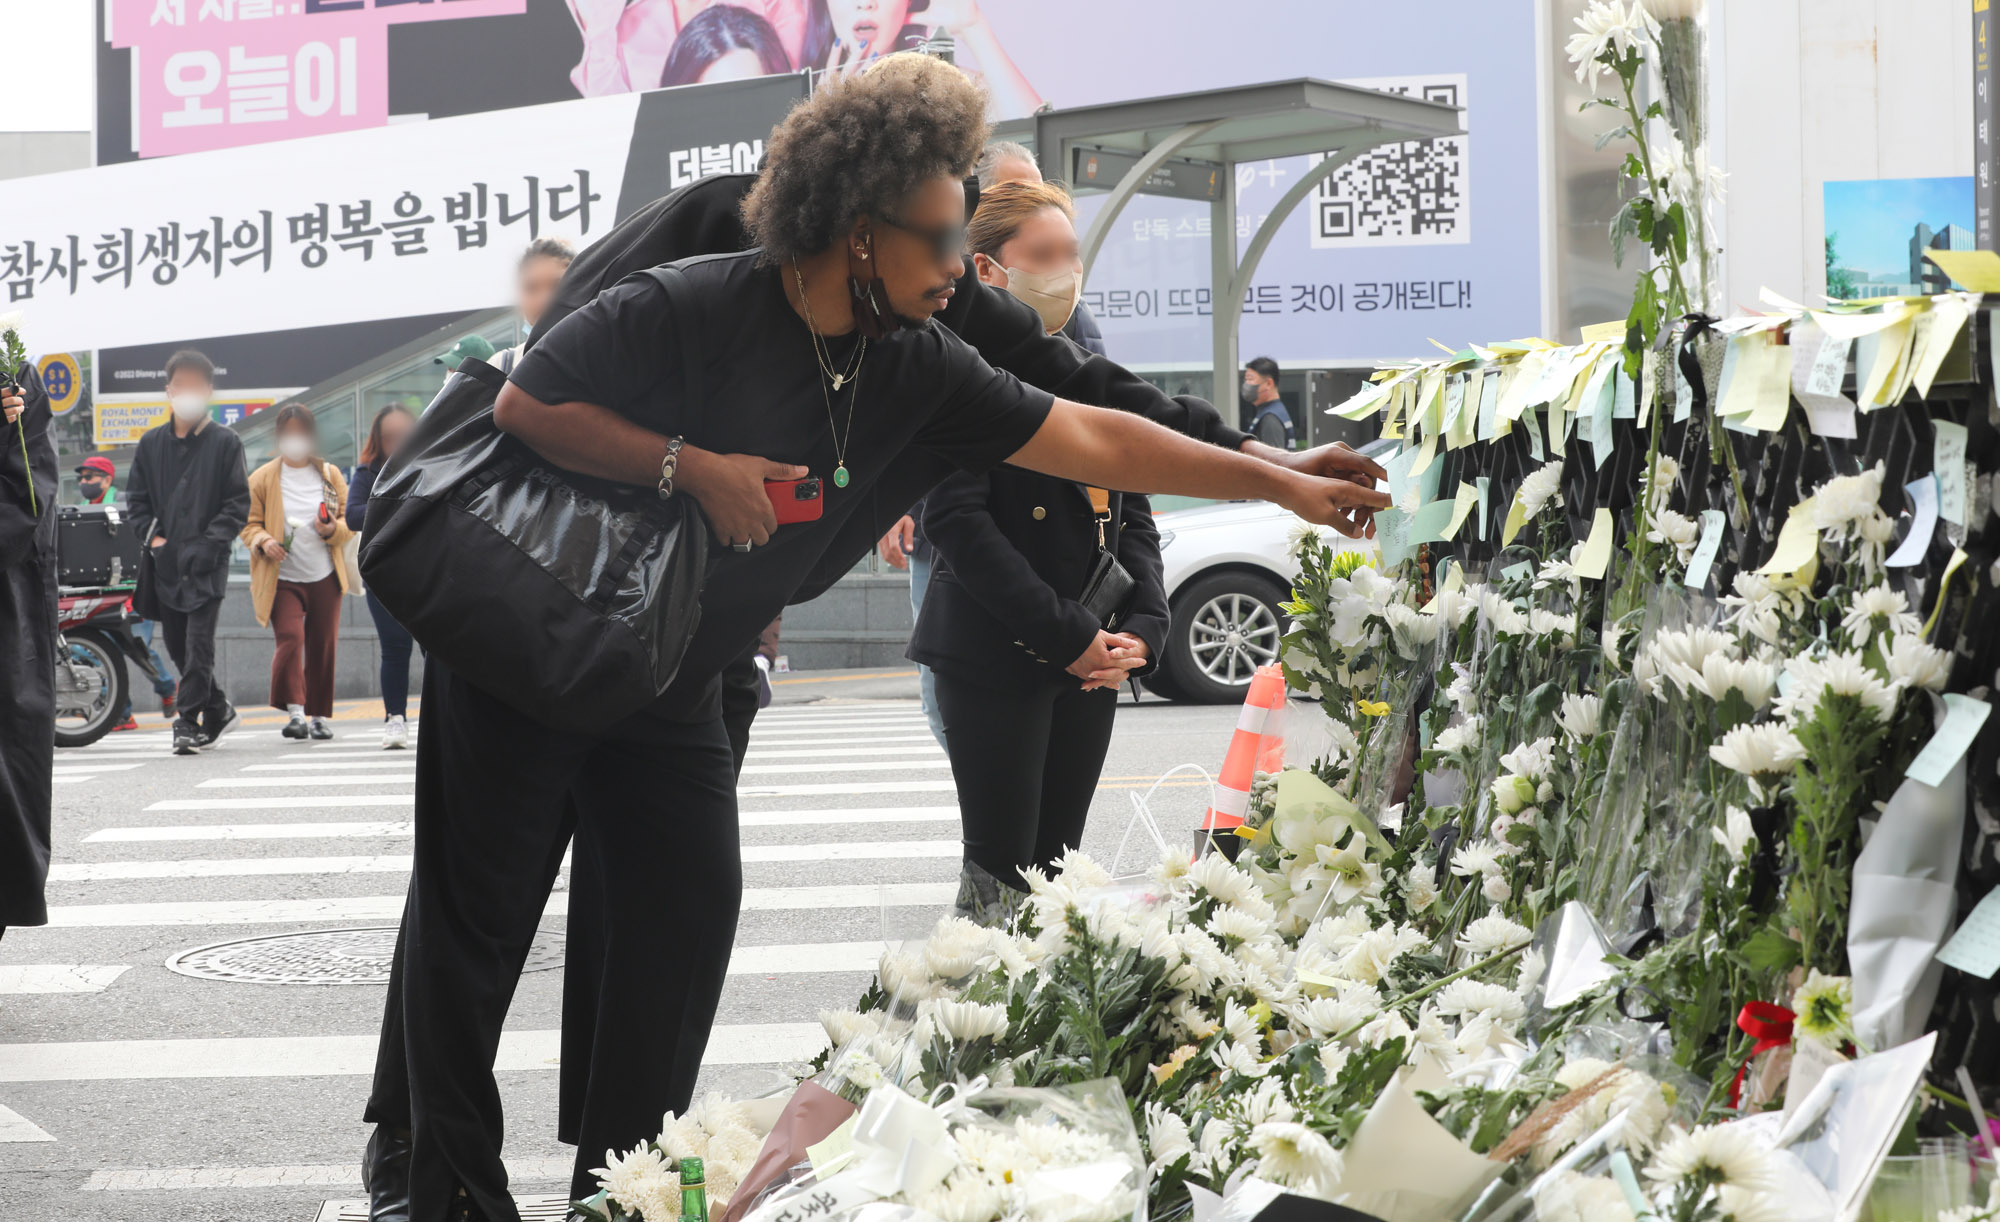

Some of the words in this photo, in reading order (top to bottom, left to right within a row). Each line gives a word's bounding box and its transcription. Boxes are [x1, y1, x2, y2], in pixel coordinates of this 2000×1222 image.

[1978, 20, 1987, 49] 4
[161, 36, 358, 128] 오늘이
[1978, 77, 1989, 188] 이태원
[0, 234, 88, 303] 참사
[91, 209, 273, 290] 희생자의
[286, 190, 436, 268] 명복을
[442, 168, 602, 252] 빕니다
[1132, 217, 1171, 241] 단독
[1175, 214, 1251, 238] 스트밍
[1290, 283, 1344, 313] 것이
[1353, 279, 1472, 312] 공개된다!
[135, 368, 157, 379] Disney
[101, 407, 129, 417] ROYAL
[131, 406, 165, 416] MONEY
[101, 418, 150, 427] EXCHANGE
